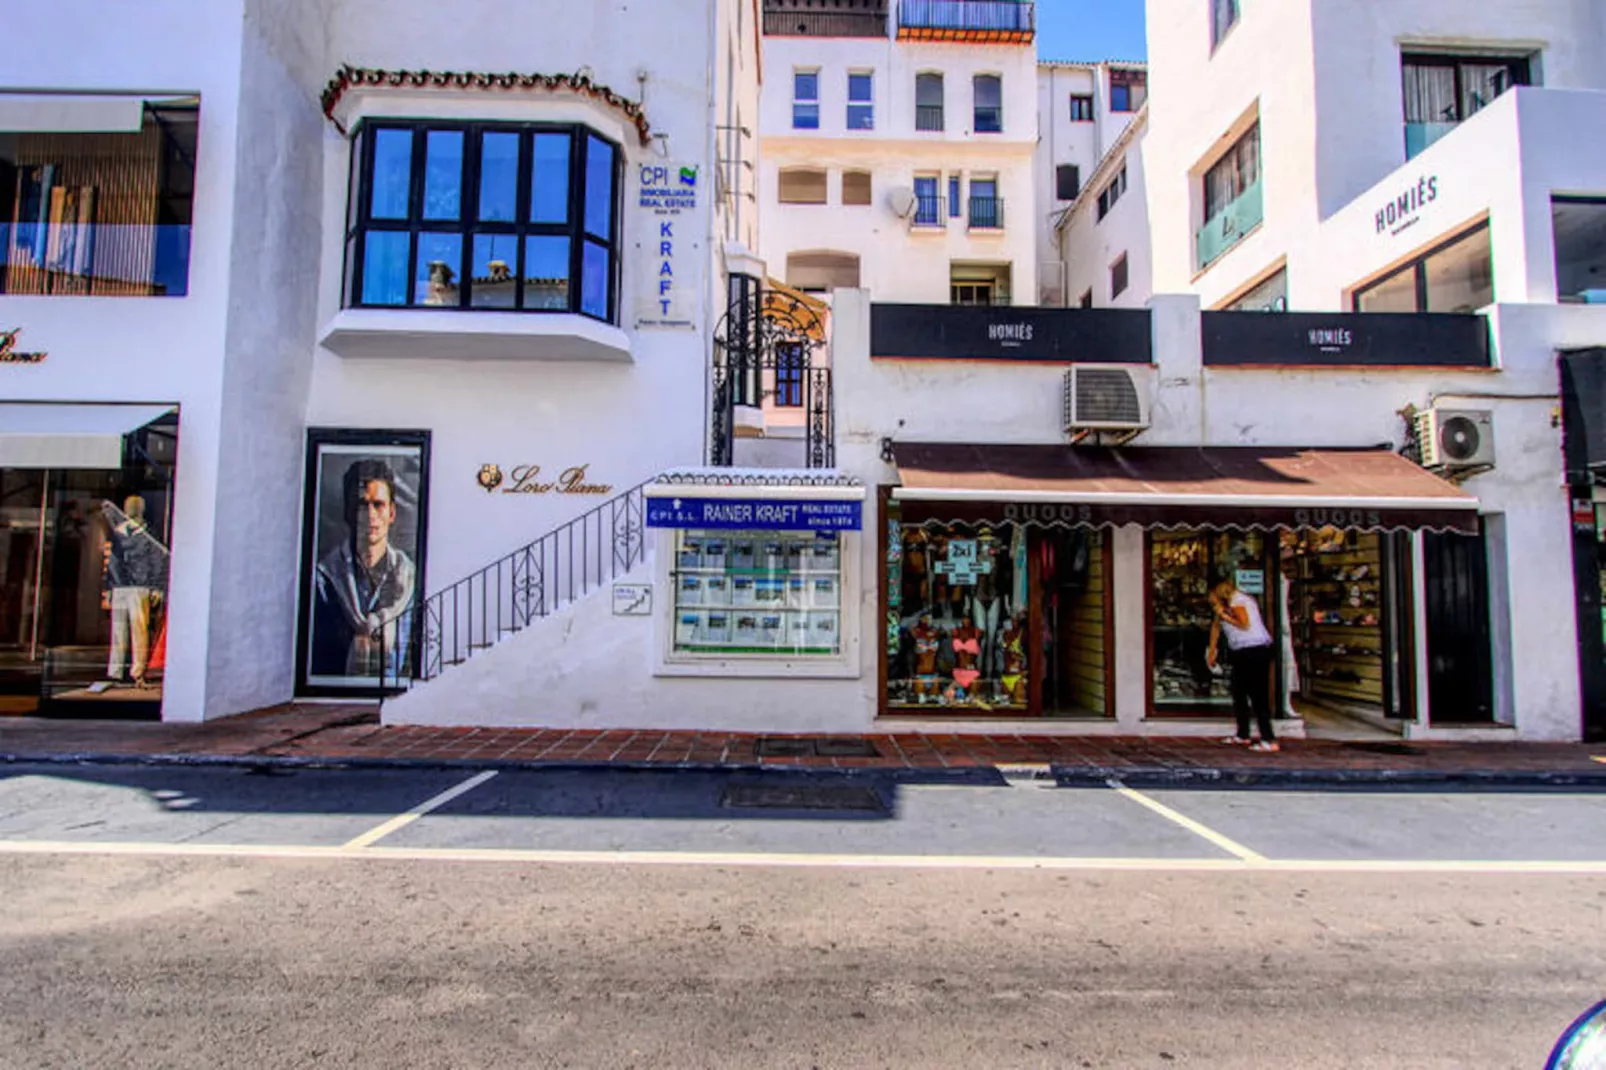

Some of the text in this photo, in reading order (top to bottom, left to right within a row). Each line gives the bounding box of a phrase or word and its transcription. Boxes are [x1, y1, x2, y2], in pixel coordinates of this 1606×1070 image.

[640, 167, 668, 185] CPI
[640, 199, 696, 208] REAL ESTATE
[1375, 174, 1438, 234] HOMIÉS
[660, 222, 673, 316] KRAFT
[988, 321, 1033, 340] HOMIÉS
[1308, 326, 1353, 345] HOMIÉS
[502, 463, 612, 493] Loro Piana
[704, 503, 799, 524] RAINER KRAFT
[802, 504, 852, 514] REAL ESTATE
